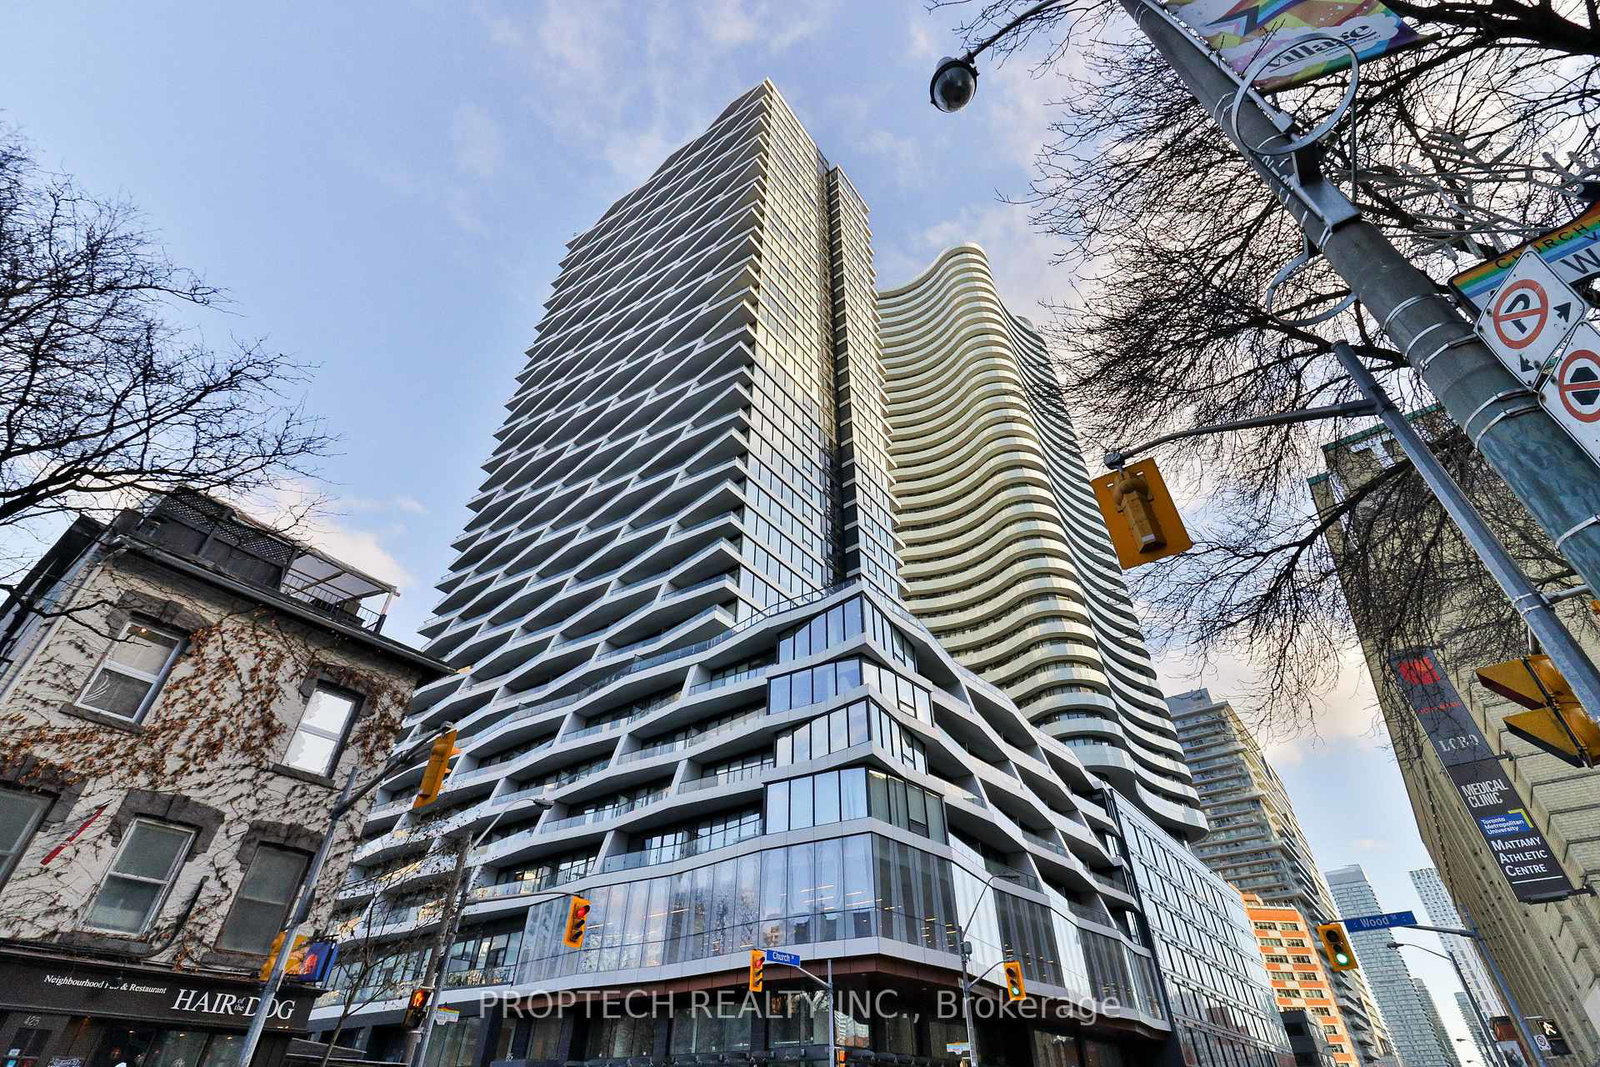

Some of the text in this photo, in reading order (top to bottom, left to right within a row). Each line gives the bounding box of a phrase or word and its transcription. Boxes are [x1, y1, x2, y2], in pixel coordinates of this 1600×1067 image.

[1460, 778, 1509, 797] MEDICAL
[1467, 792, 1503, 808] CLINIC
[1480, 817, 1506, 825] Toronto
[1484, 819, 1524, 830] Metropolitan
[1487, 826, 1519, 835] University
[1490, 836, 1541, 852] MATTAMY
[1499, 849, 1548, 864] ATHLETIC
[1505, 863, 1547, 877] CENTRE
[1360, 916, 1389, 928] Wood
[772, 951, 791, 963] Church
[43, 974, 105, 989] Neighbourhood
[129, 983, 167, 995] Restaurant
[171, 988, 236, 1016] HAIR
